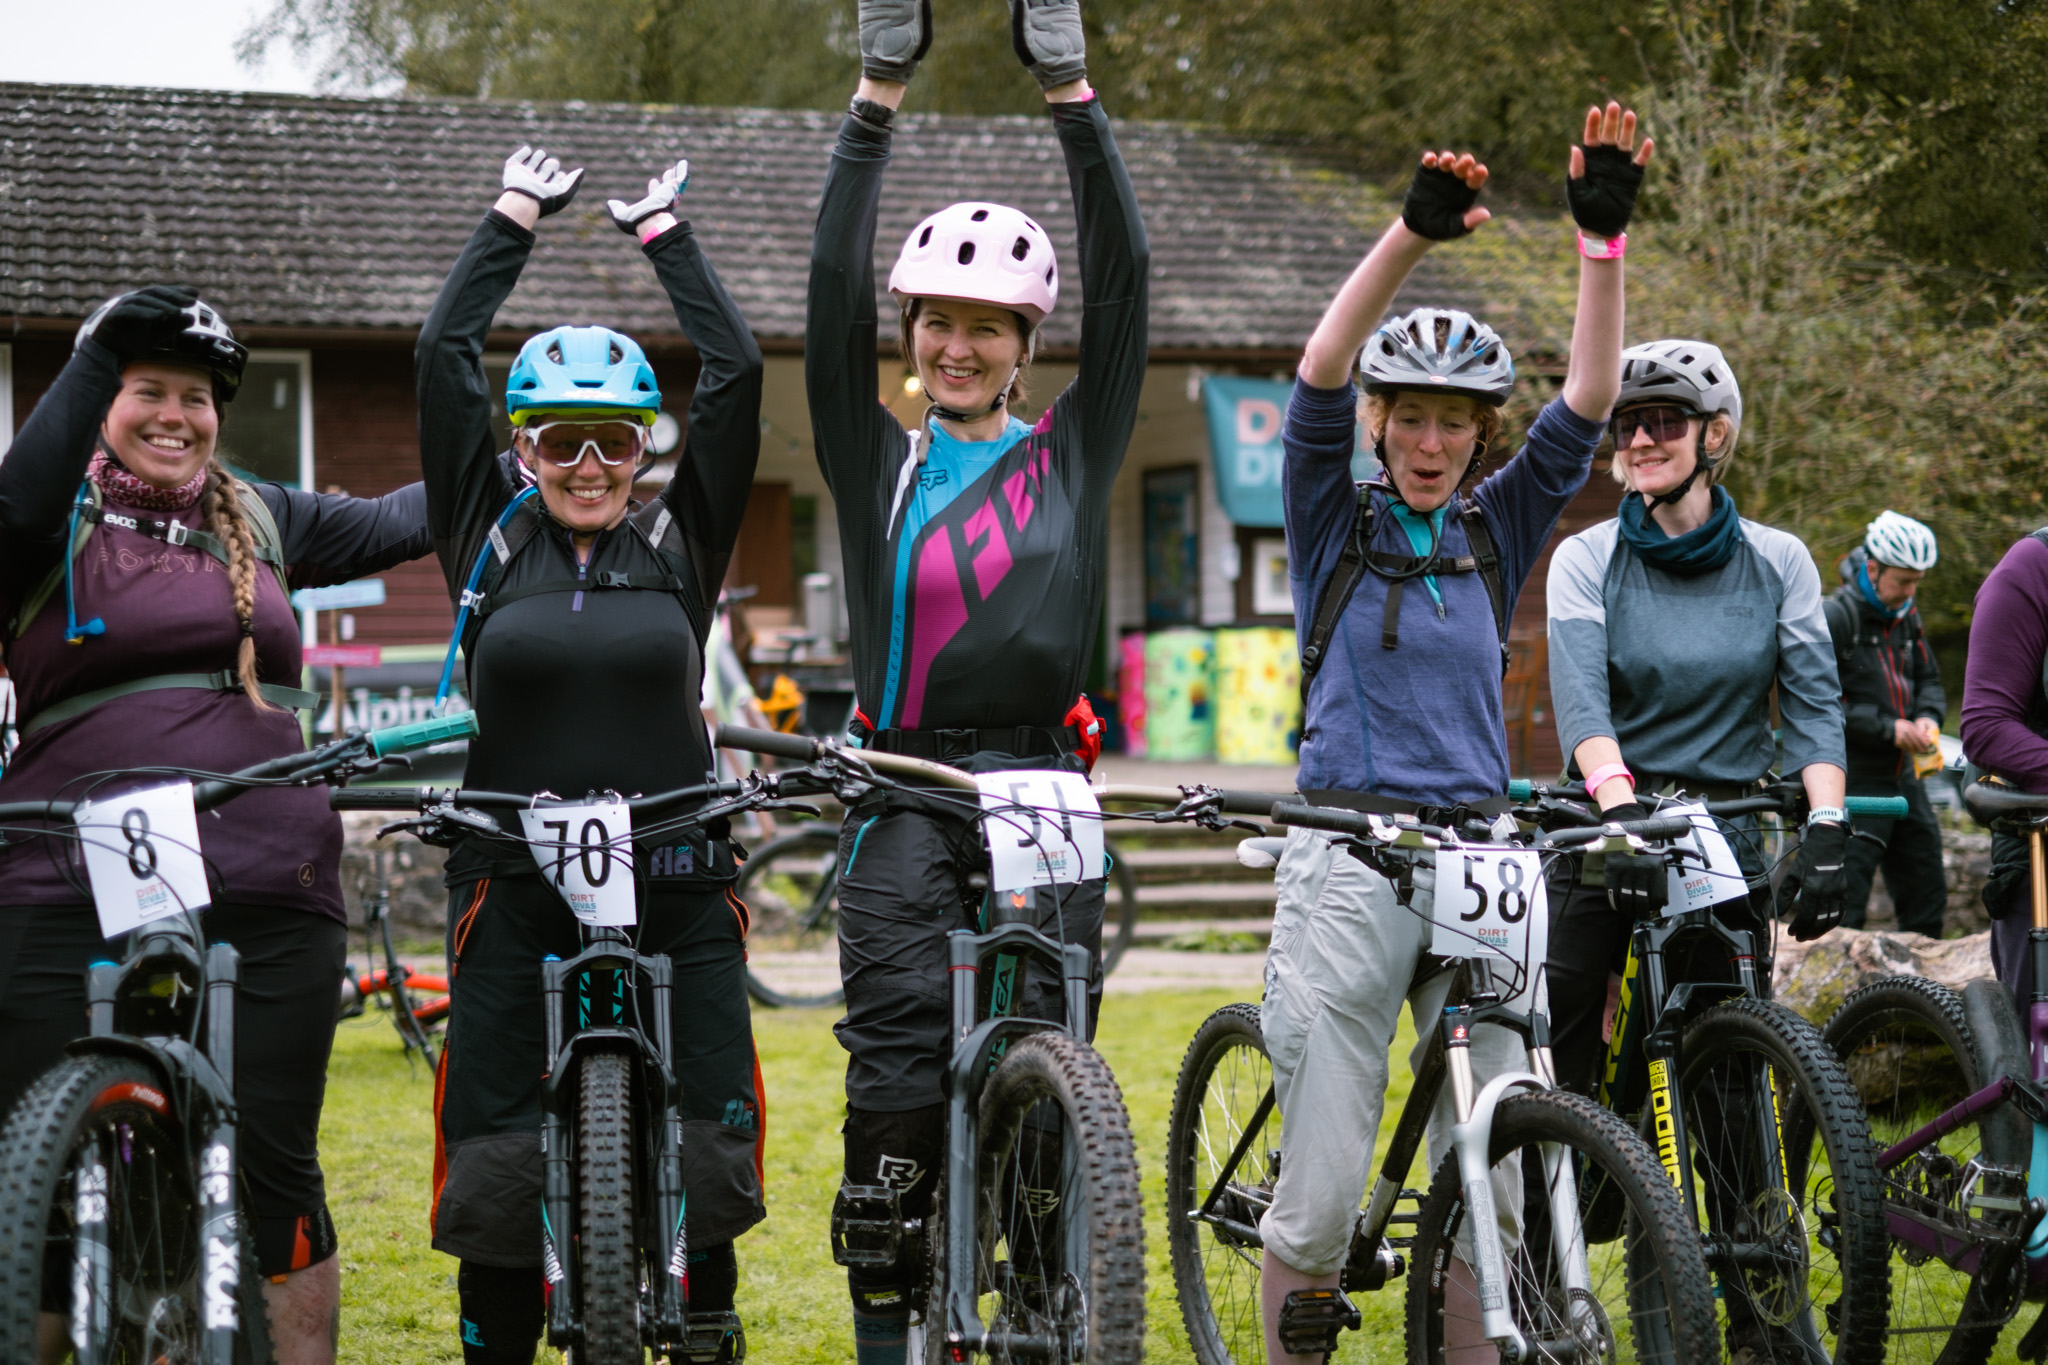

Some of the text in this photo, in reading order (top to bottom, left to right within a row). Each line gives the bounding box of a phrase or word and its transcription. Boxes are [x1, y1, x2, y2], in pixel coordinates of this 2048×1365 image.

[1008, 781, 1073, 849] 51
[121, 807, 157, 881] 8
[543, 818, 611, 889] 70
[1037, 850, 1066, 861] DIRT
[1037, 859, 1067, 869] DIVAS
[1461, 855, 1527, 923] 58
[1684, 876, 1709, 890] DIRT
[1686, 883, 1713, 895] DIVAS
[136, 882, 164, 899] DIRT
[570, 894, 595, 902] DIRT
[572, 902, 596, 910] DIVAS
[1478, 928, 1509, 937] DIRT
[1478, 936, 1509, 944] DIVAS
[1652, 1090, 1684, 1204] DOMA
[1471, 1180, 1500, 1279] RECON
[207, 1237, 240, 1330] FOX
[1481, 1283, 1500, 1296] ROCK
[1482, 1297, 1503, 1309] SHOX
